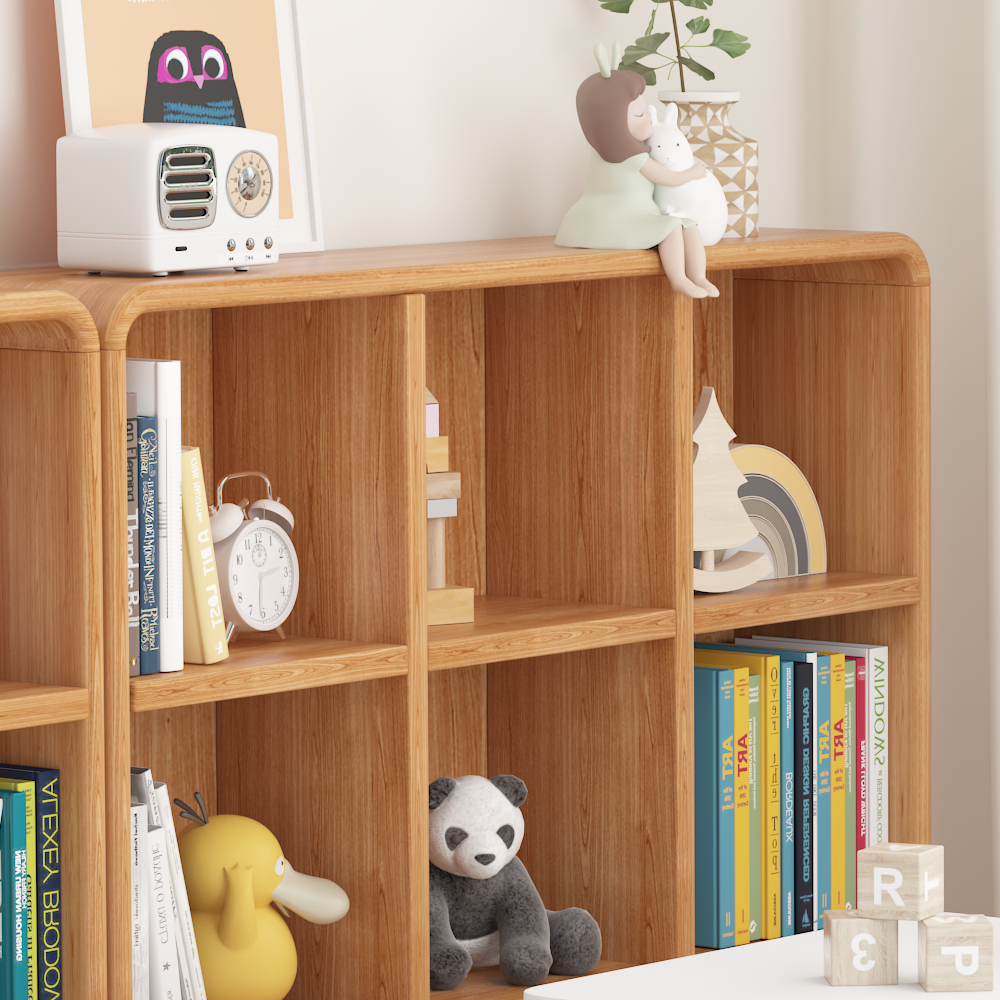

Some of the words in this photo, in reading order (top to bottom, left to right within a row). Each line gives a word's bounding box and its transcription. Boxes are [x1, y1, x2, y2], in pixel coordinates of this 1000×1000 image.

[255, 532, 262, 544] 12
[269, 535, 272, 546] 1
[244, 539, 251, 550] 11
[278, 548, 284, 559] 2
[236, 554, 243, 565] 10
[283, 566, 288, 577] 3
[232, 574, 238, 585] 9
[280, 586, 285, 597] 4
[237, 592, 243, 603] 8
[248, 604, 253, 616] 7
[274, 600, 279, 612] 5
[260, 607, 266, 619] 6
[873, 867, 906, 907] R
